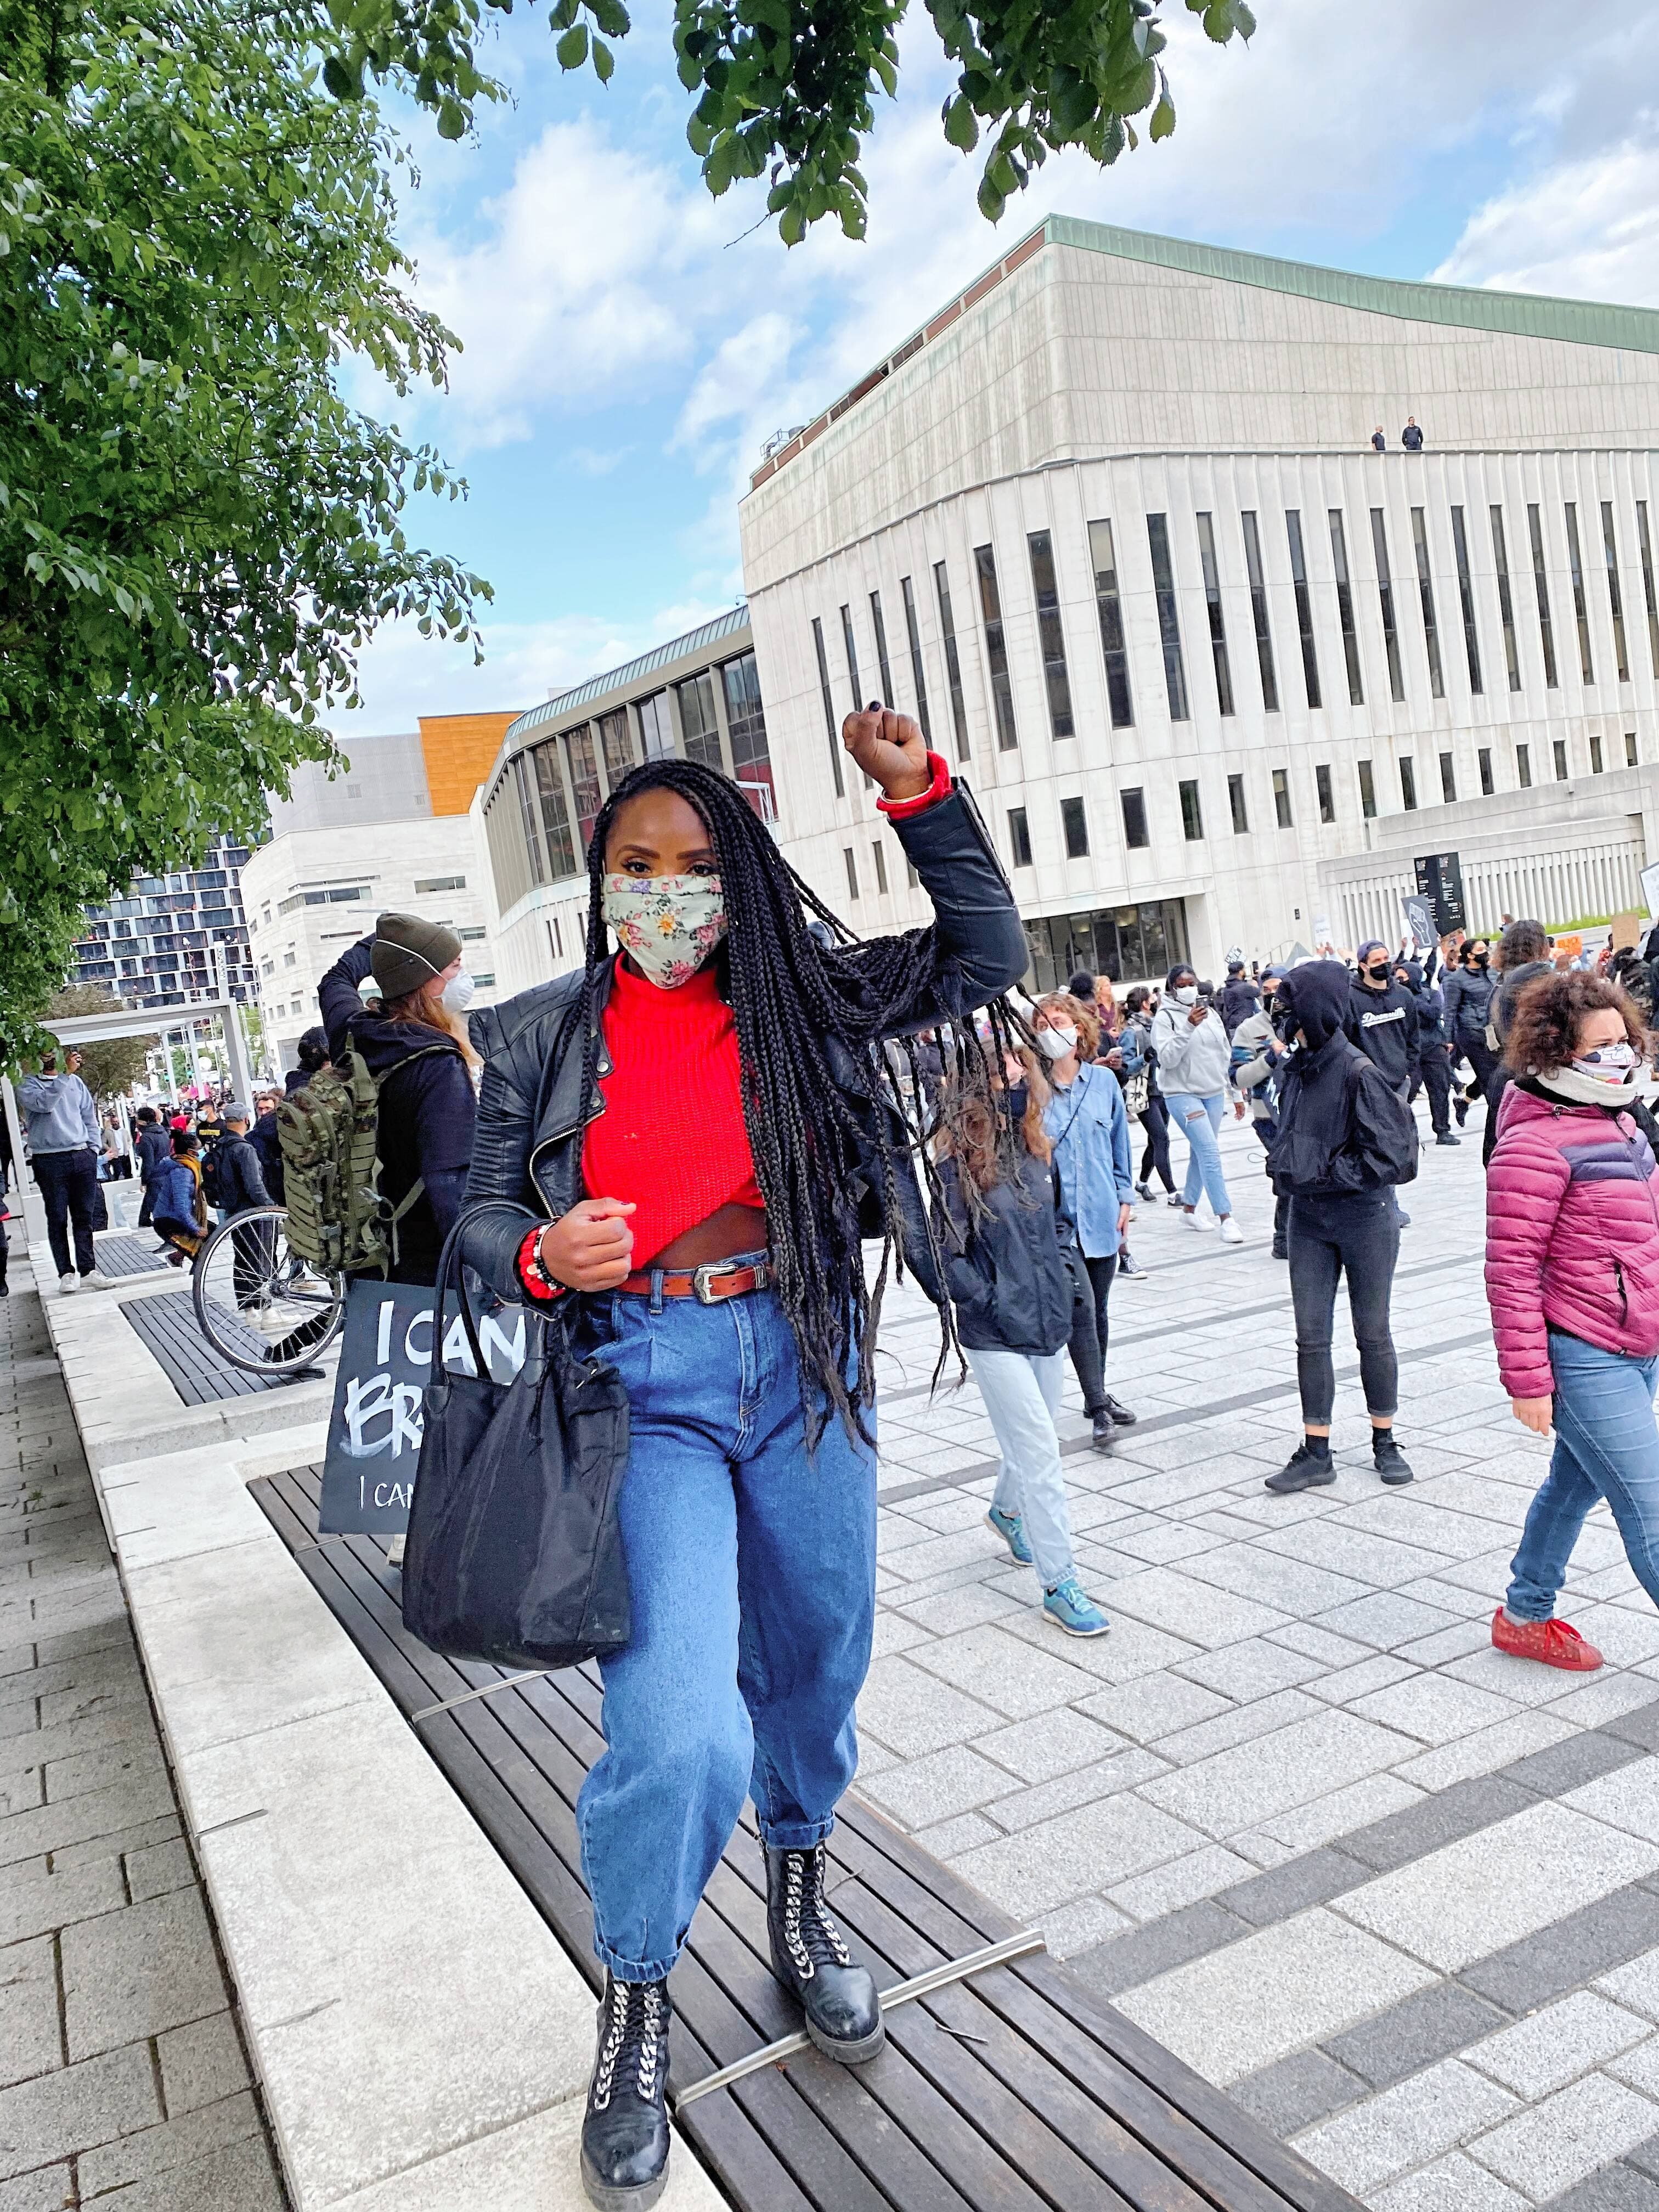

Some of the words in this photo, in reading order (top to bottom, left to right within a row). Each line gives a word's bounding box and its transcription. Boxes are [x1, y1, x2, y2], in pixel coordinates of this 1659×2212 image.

[376, 1300, 394, 1365] I
[405, 1310, 526, 1378] CAN
[360, 1475, 365, 1510] I
